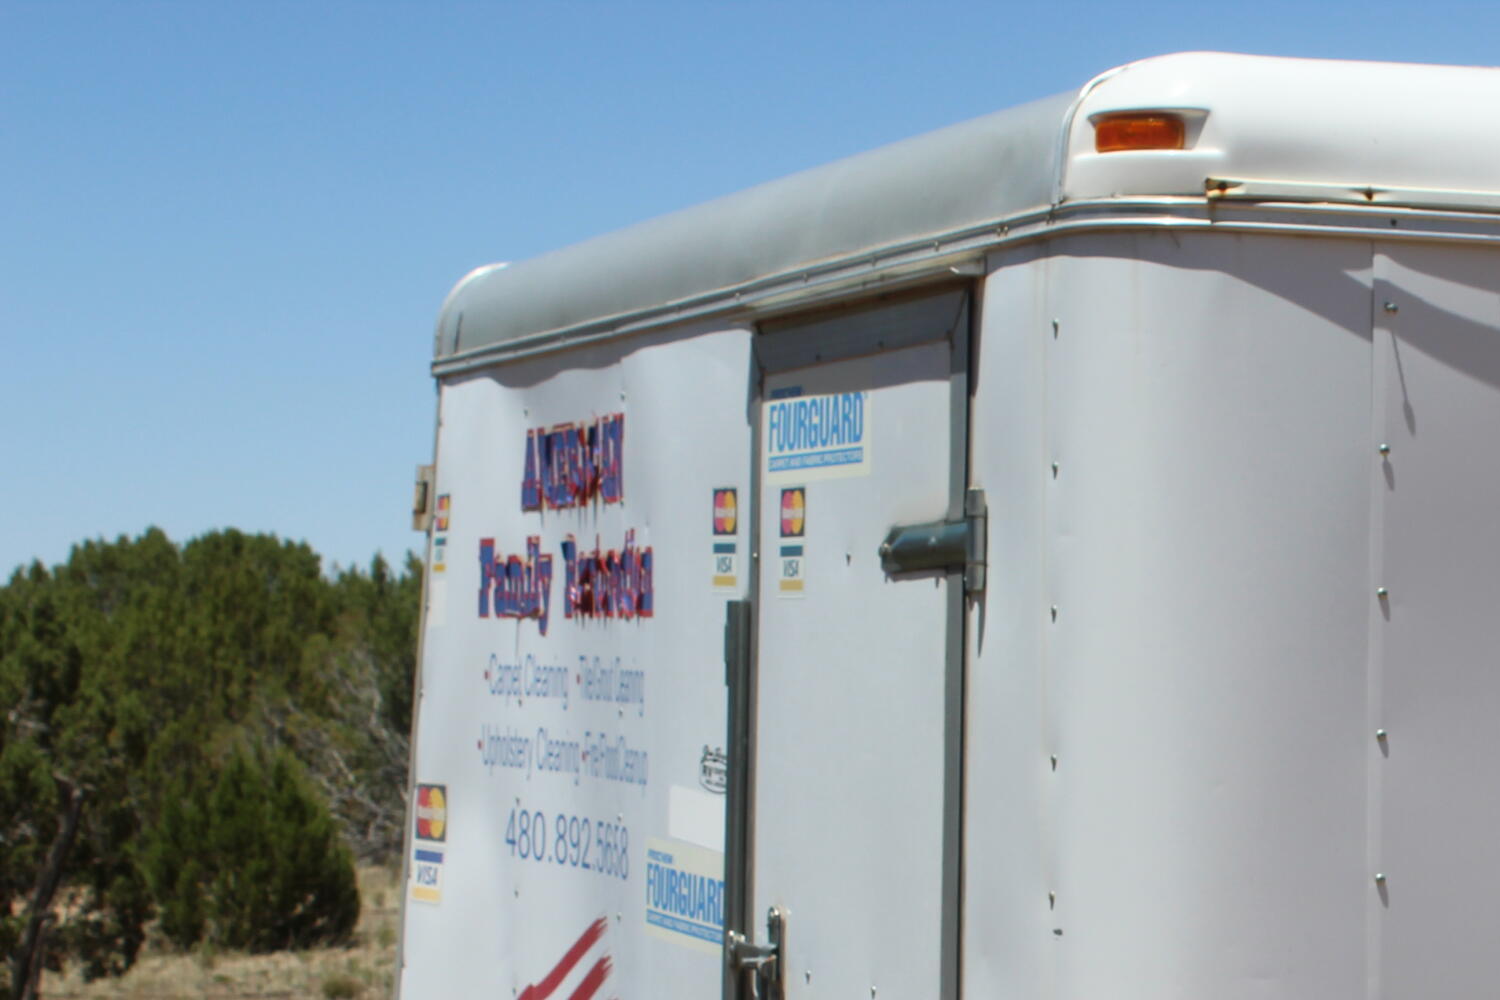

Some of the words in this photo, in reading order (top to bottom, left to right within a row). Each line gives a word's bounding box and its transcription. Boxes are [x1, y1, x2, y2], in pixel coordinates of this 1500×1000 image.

[769, 391, 863, 453] FOURGUARD
[489, 652, 523, 707] Carpet
[525, 653, 568, 711] Cleaning
[482, 723, 533, 781] Upholstery
[536, 726, 580, 786] Cleaning
